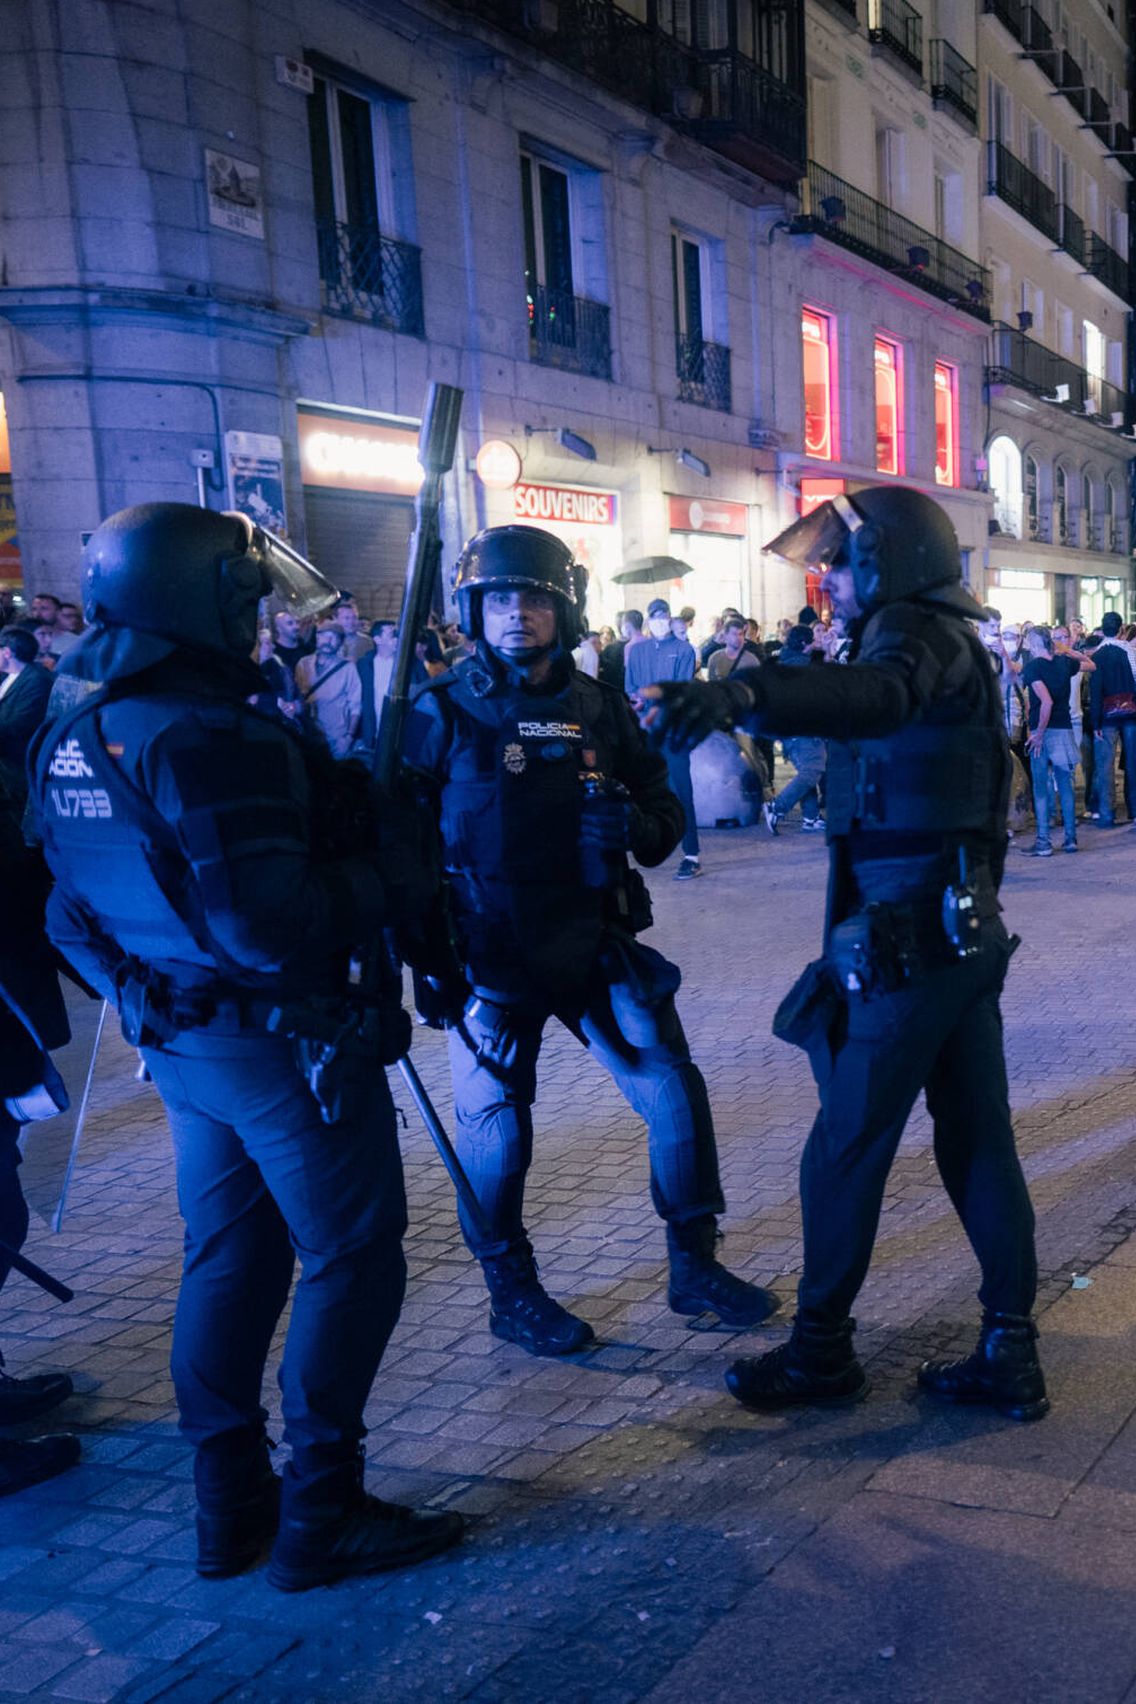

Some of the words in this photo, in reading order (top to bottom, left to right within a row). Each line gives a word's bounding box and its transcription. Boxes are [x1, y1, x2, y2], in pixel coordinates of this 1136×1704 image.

[514, 486, 610, 523] SOUVENIRS
[518, 721, 568, 730] POLICIA
[519, 729, 582, 738] NACIONAL
